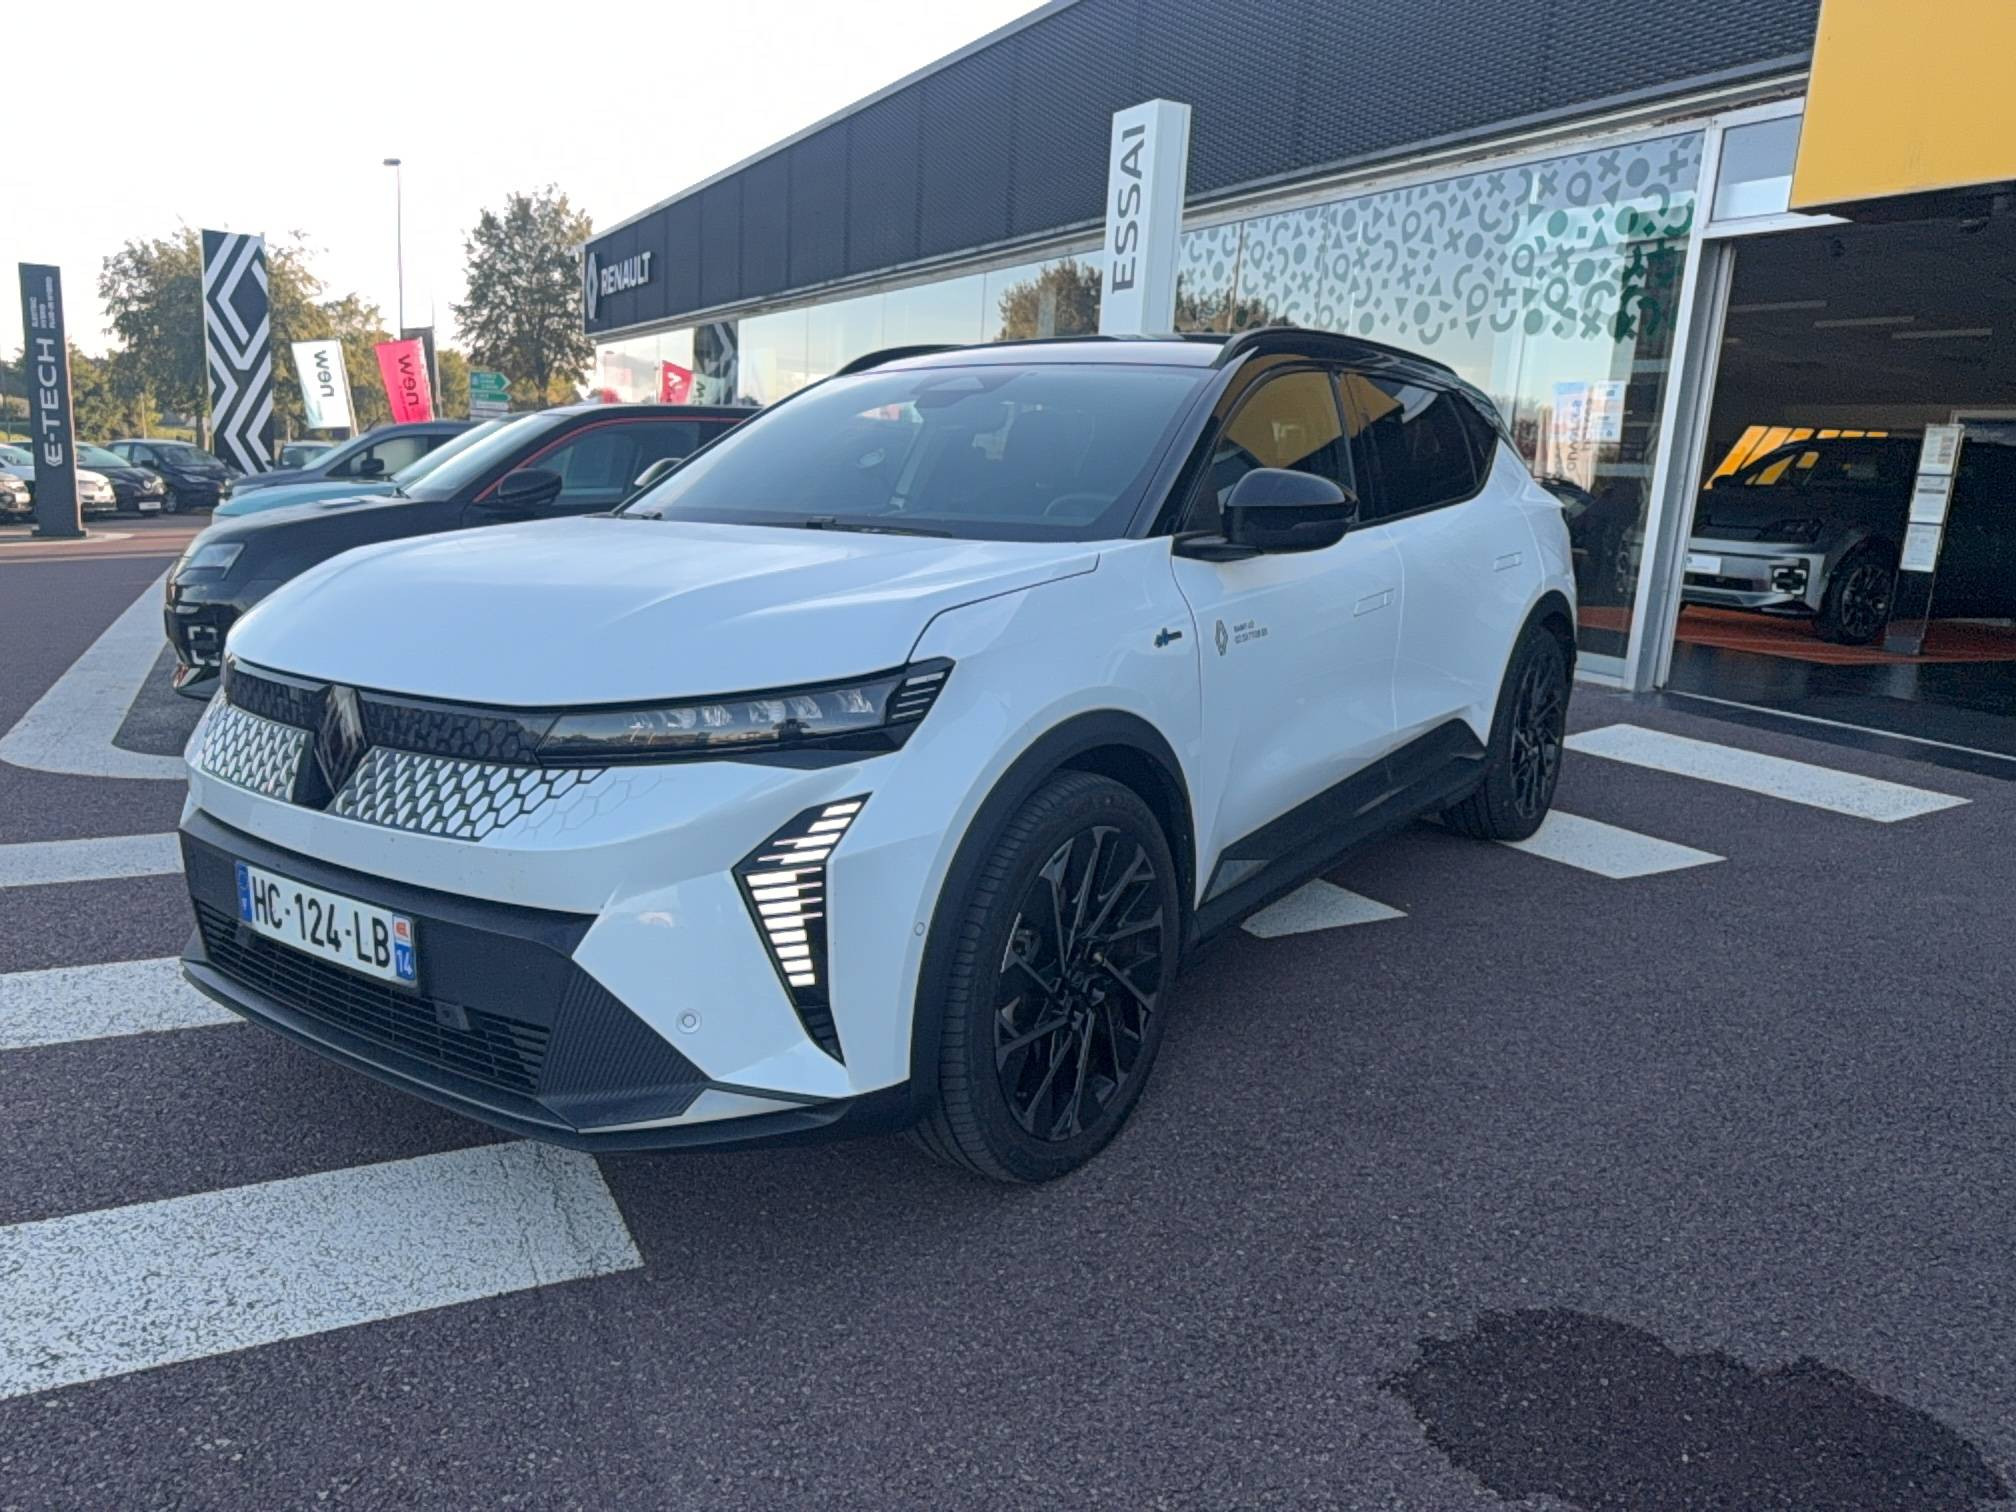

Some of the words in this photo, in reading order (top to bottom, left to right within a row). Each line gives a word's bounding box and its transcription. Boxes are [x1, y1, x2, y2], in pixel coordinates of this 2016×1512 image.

[1112, 124, 1145, 292] ESSAI
[600, 251, 651, 296] RENAULT
[36, 337, 63, 467] E-TECH
[252, 876, 391, 968] HC-124-LB
[397, 950, 413, 975] 14
